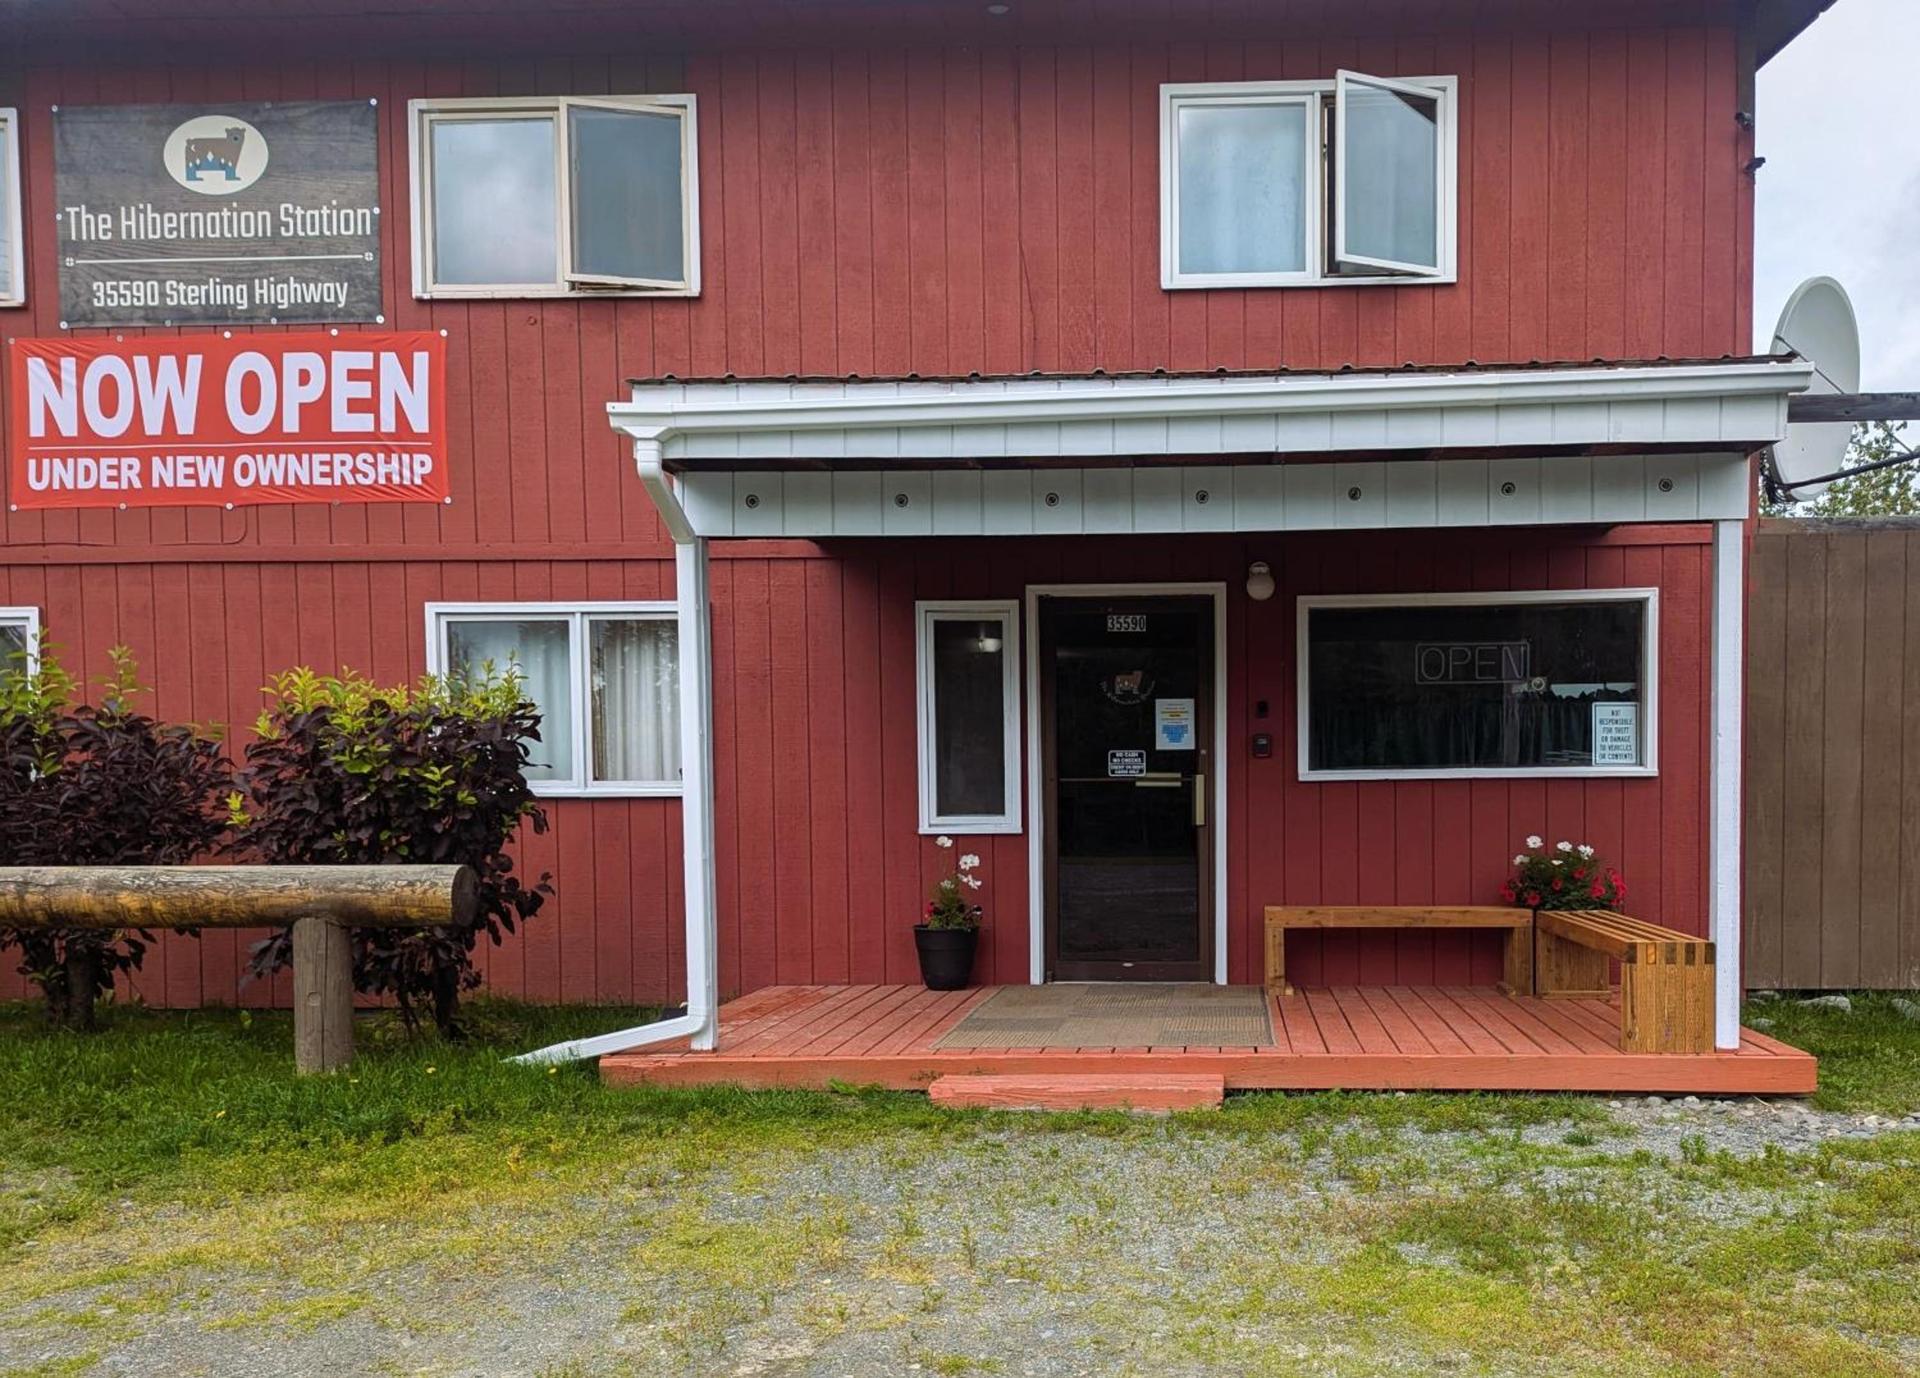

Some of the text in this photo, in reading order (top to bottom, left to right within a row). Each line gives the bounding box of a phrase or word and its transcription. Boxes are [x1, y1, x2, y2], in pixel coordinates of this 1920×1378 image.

[65, 199, 372, 241] The Hibernation Station
[92, 277, 349, 309] 35590 Sterling Highway
[27, 350, 430, 438] NOW OPEN
[28, 453, 433, 491] UNDER NEW OWNERSHIP
[1107, 615, 1146, 632] 35590
[1421, 647, 1524, 680] OPEN
